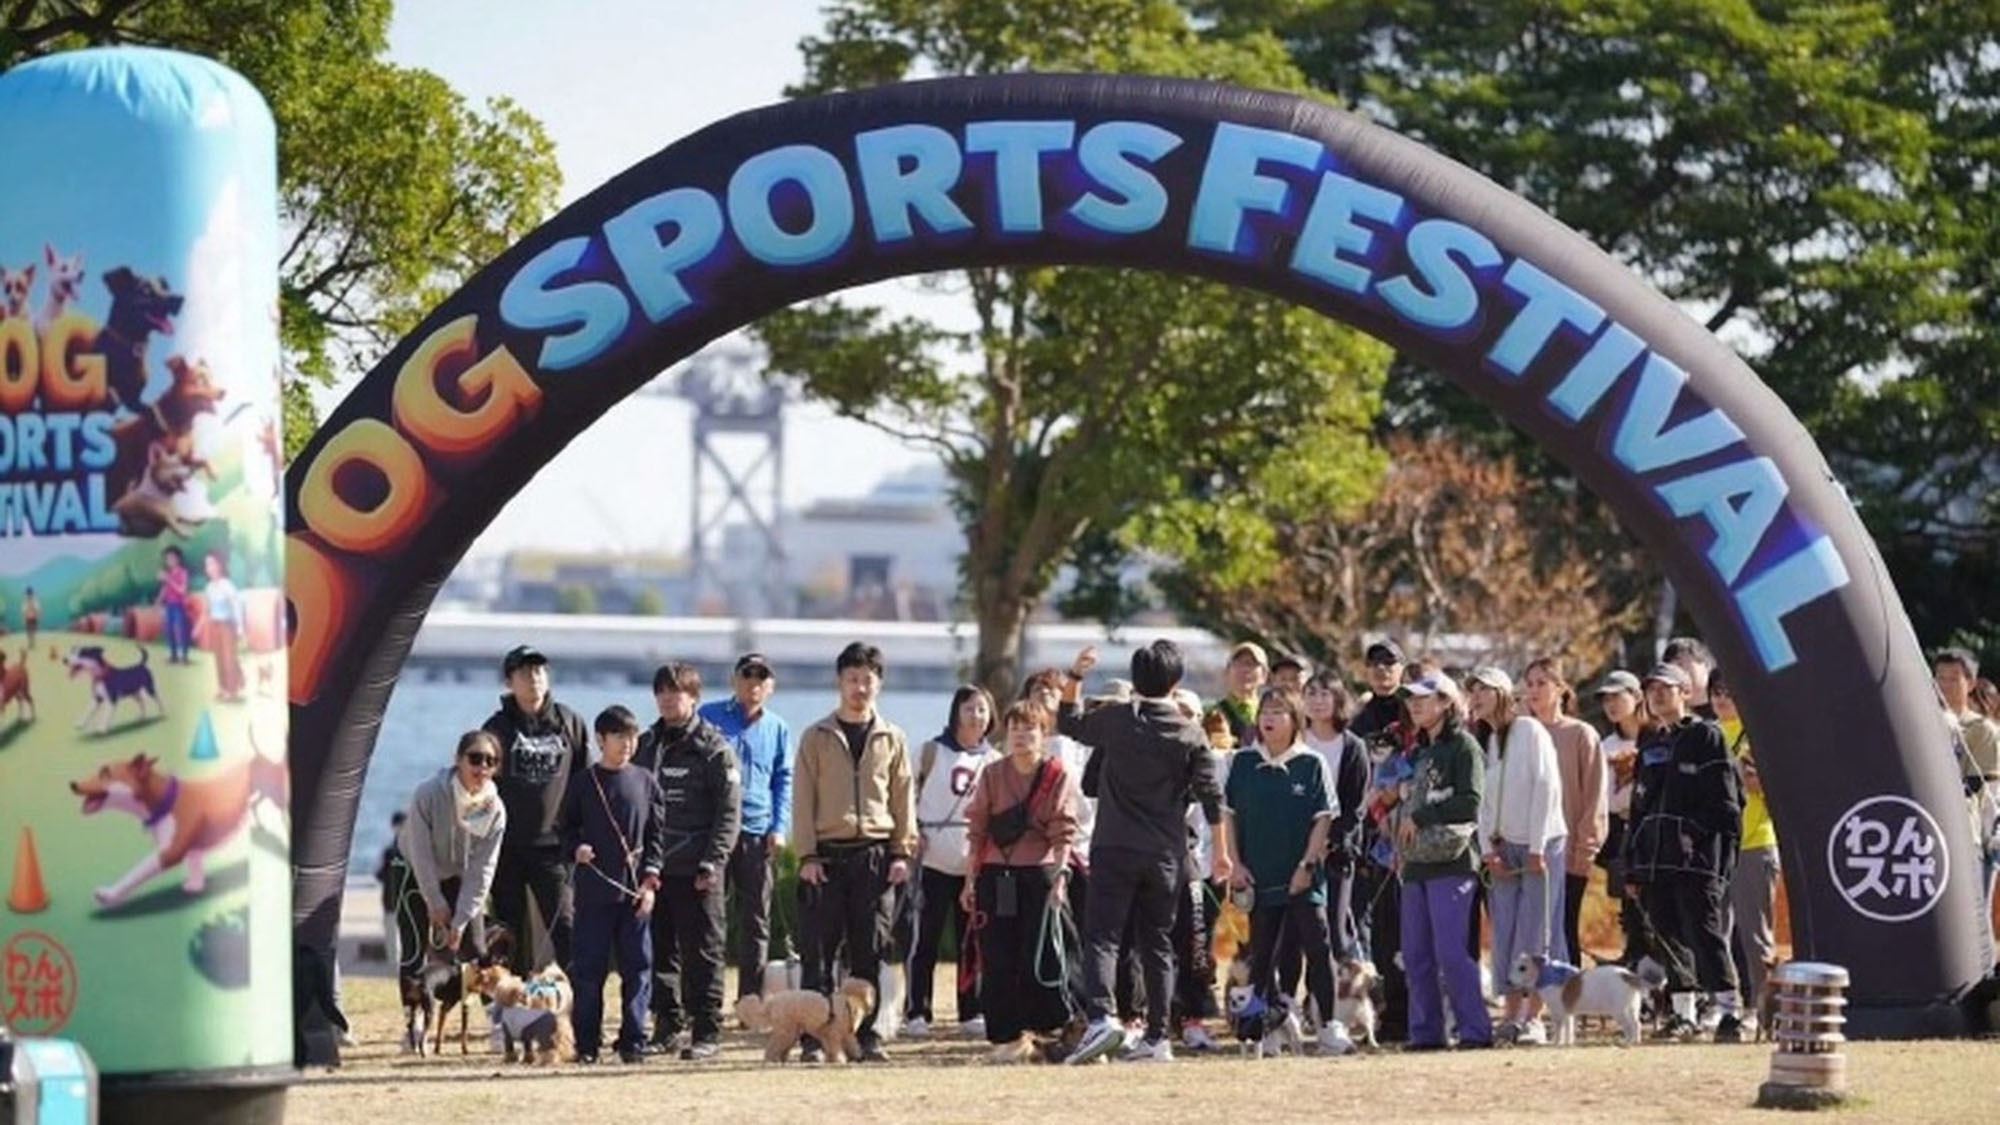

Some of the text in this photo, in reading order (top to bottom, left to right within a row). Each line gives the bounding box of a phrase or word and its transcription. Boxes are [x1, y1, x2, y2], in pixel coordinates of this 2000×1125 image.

[500, 120, 1184, 371] SPORTS
[1187, 121, 1850, 674] FESTIVAL
[1845, 815, 1934, 856] わん
[1846, 856, 1936, 899] スポ
